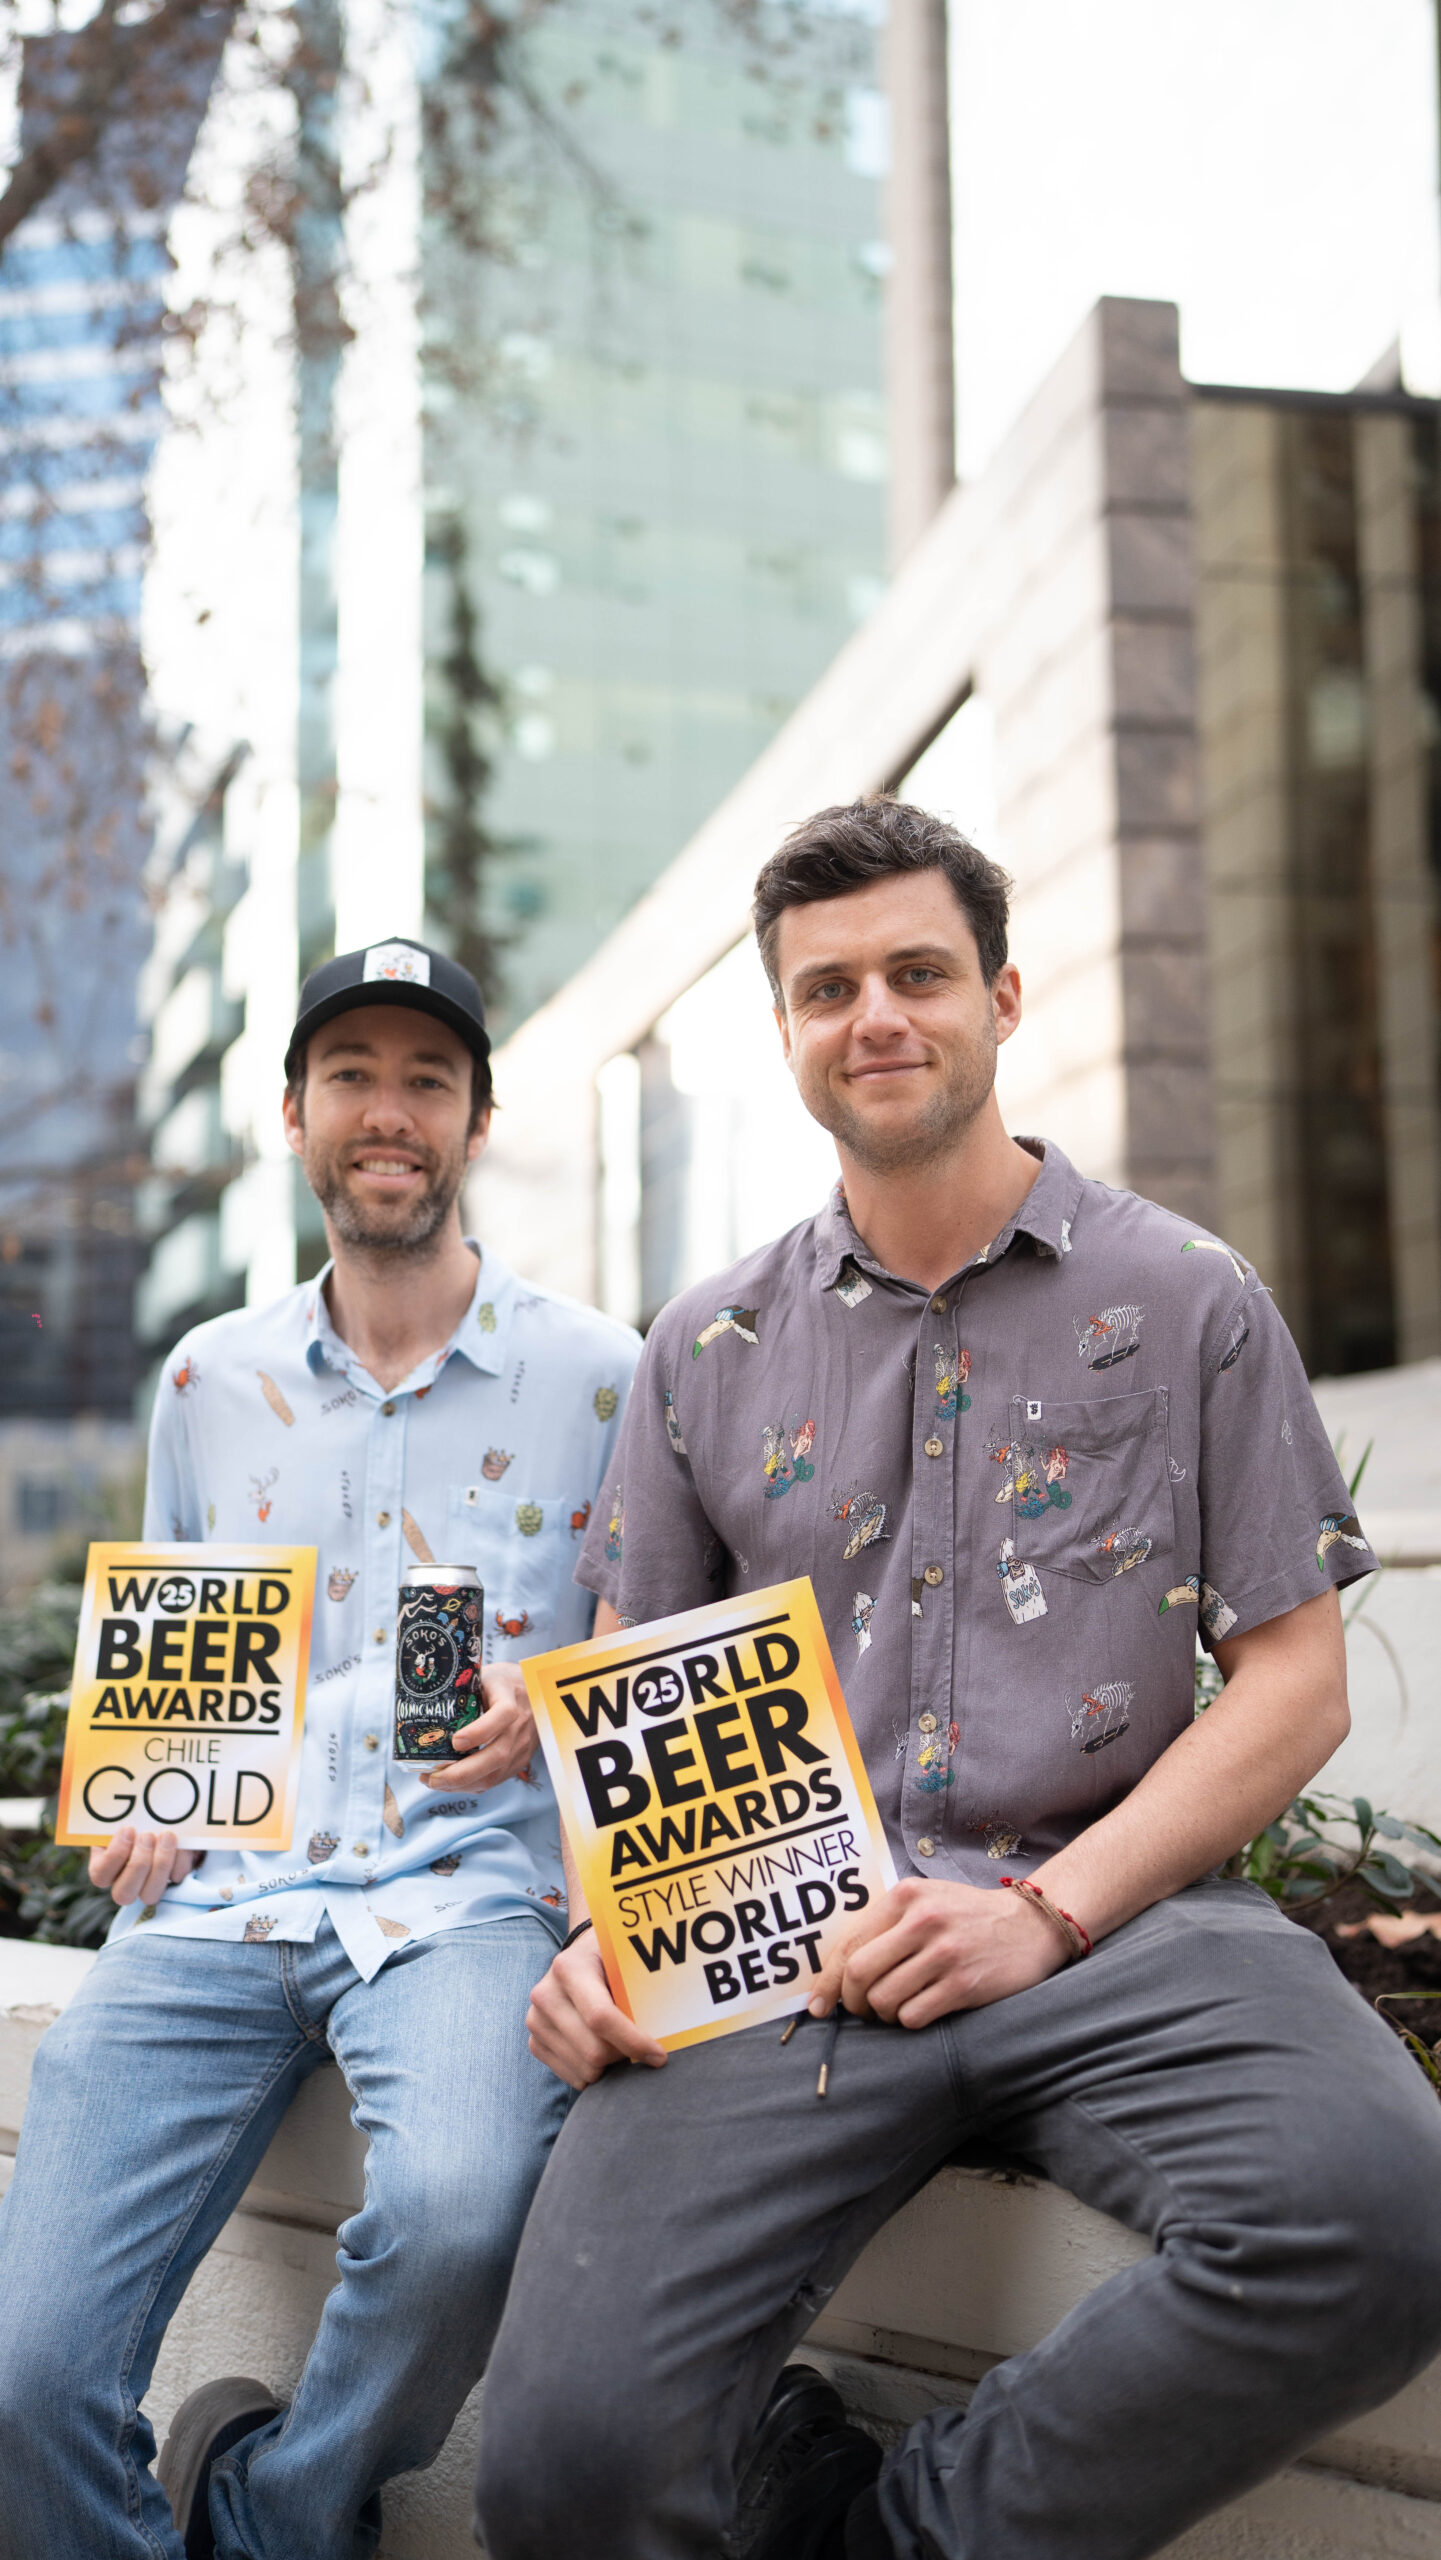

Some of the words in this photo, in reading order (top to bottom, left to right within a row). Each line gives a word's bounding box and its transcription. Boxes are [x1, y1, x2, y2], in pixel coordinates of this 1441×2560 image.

[161, 1584, 194, 1607] 25
[95, 1618, 282, 1685] BEER
[405, 1629, 447, 1648] SOKO'S
[92, 1686, 281, 1724] AWARDS
[396, 1699, 423, 1721] COSMIC
[425, 1699, 456, 1720] WALK
[638, 1675, 678, 1710] 25
[144, 1737, 221, 1764] CHILE
[574, 1688, 830, 1829] BEER
[83, 1765, 275, 1826] GOLD
[610, 1767, 842, 1877] AWARDS
[617, 1874, 712, 1928] STYLE
[715, 1829, 861, 1897] WINNER
[628, 1867, 870, 1973] WORLD'S
[703, 1931, 823, 2005] BEST
